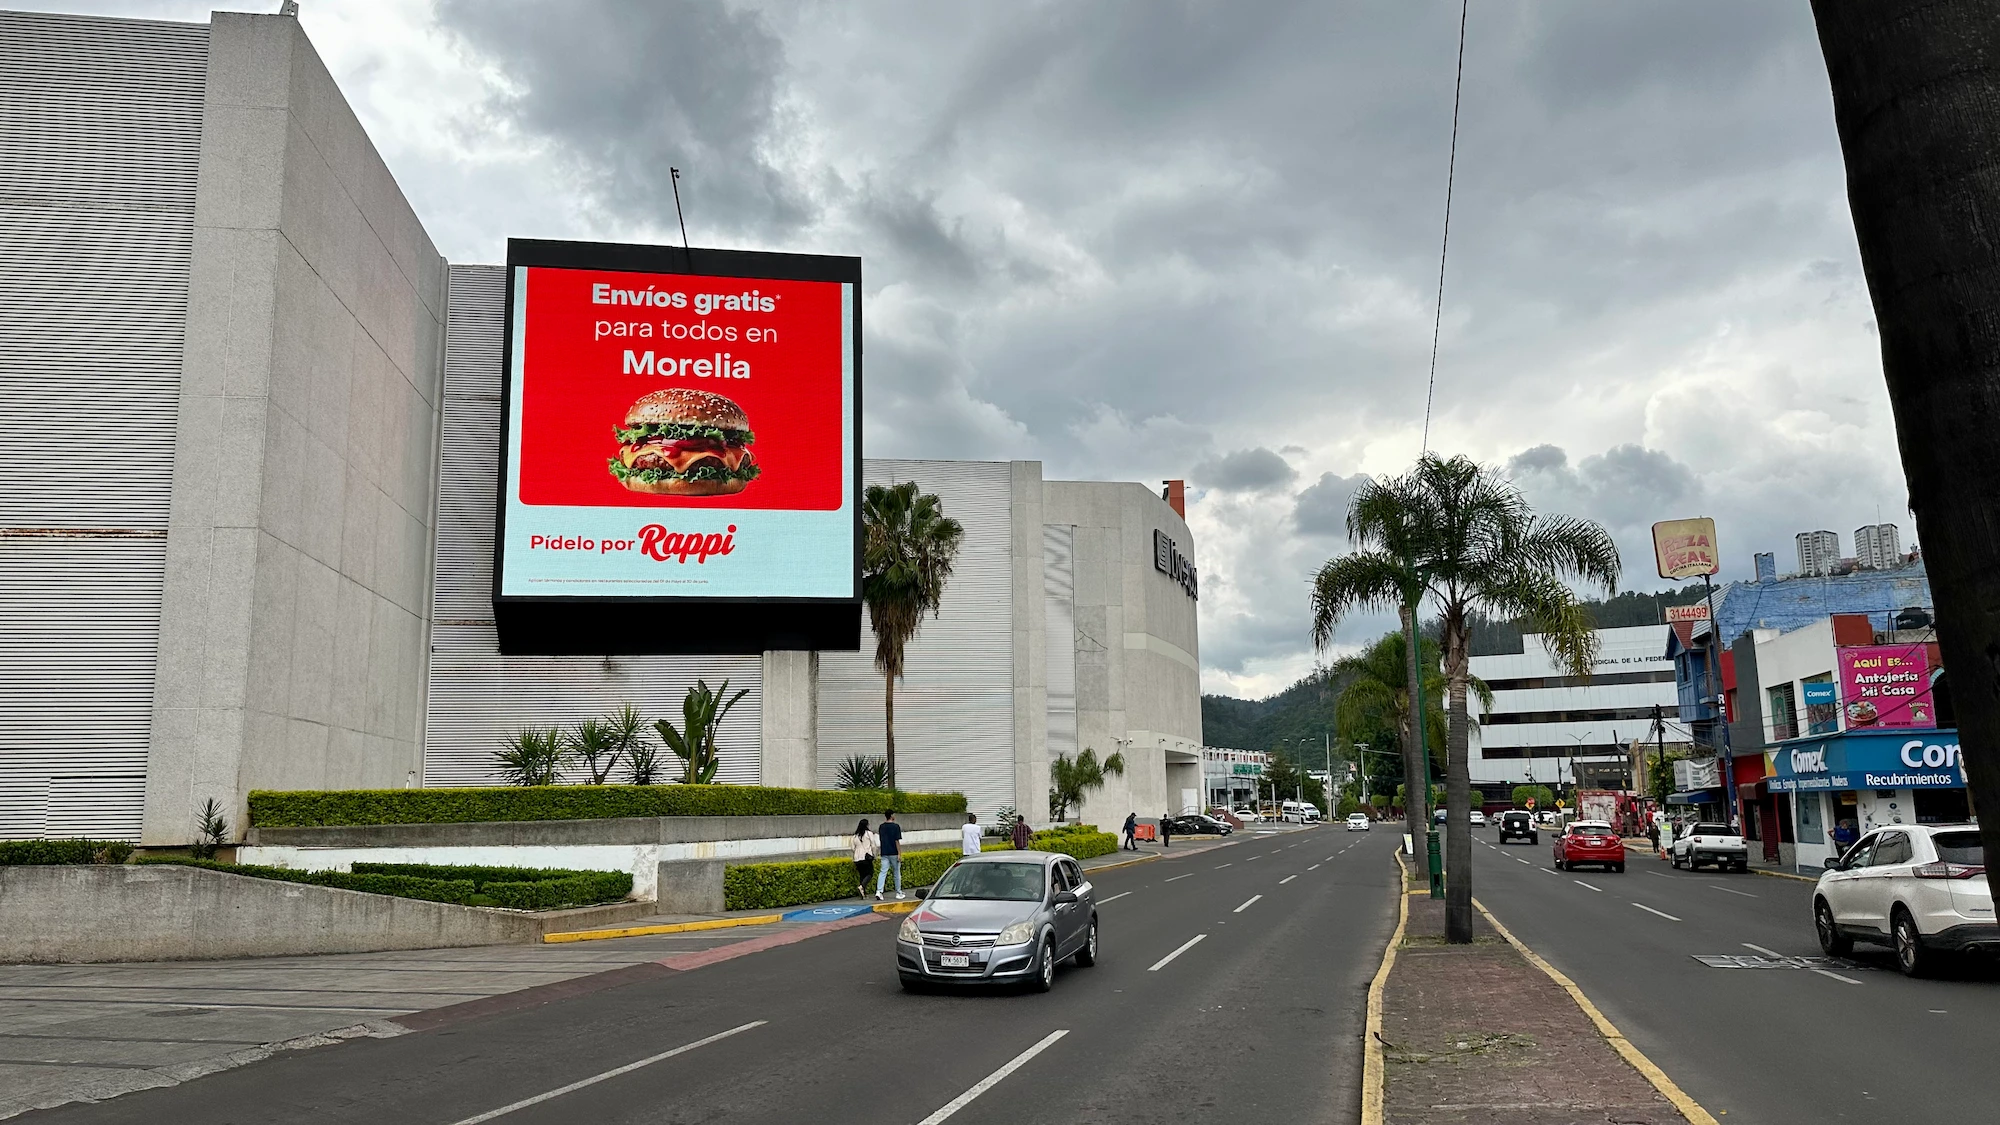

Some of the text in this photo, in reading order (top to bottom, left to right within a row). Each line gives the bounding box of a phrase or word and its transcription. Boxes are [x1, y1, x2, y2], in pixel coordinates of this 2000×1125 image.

[593, 283, 688, 308] Envíos
[595, 320, 778, 343] para todos en
[623, 350, 751, 379] Morelia
[530, 524, 737, 564] Pídelo por Rappi
[1661, 534, 1710, 555] PIZZA
[1665, 551, 1712, 570] REAL
[1669, 607, 1707, 620] 3144499
[1853, 655, 1882, 668] AQUÍ
[1855, 671, 1918, 684] Antojería
[1861, 685, 1915, 697] Mi Casa
[1790, 744, 1829, 774] Comex
[1865, 773, 1952, 786] Recubrimientos
